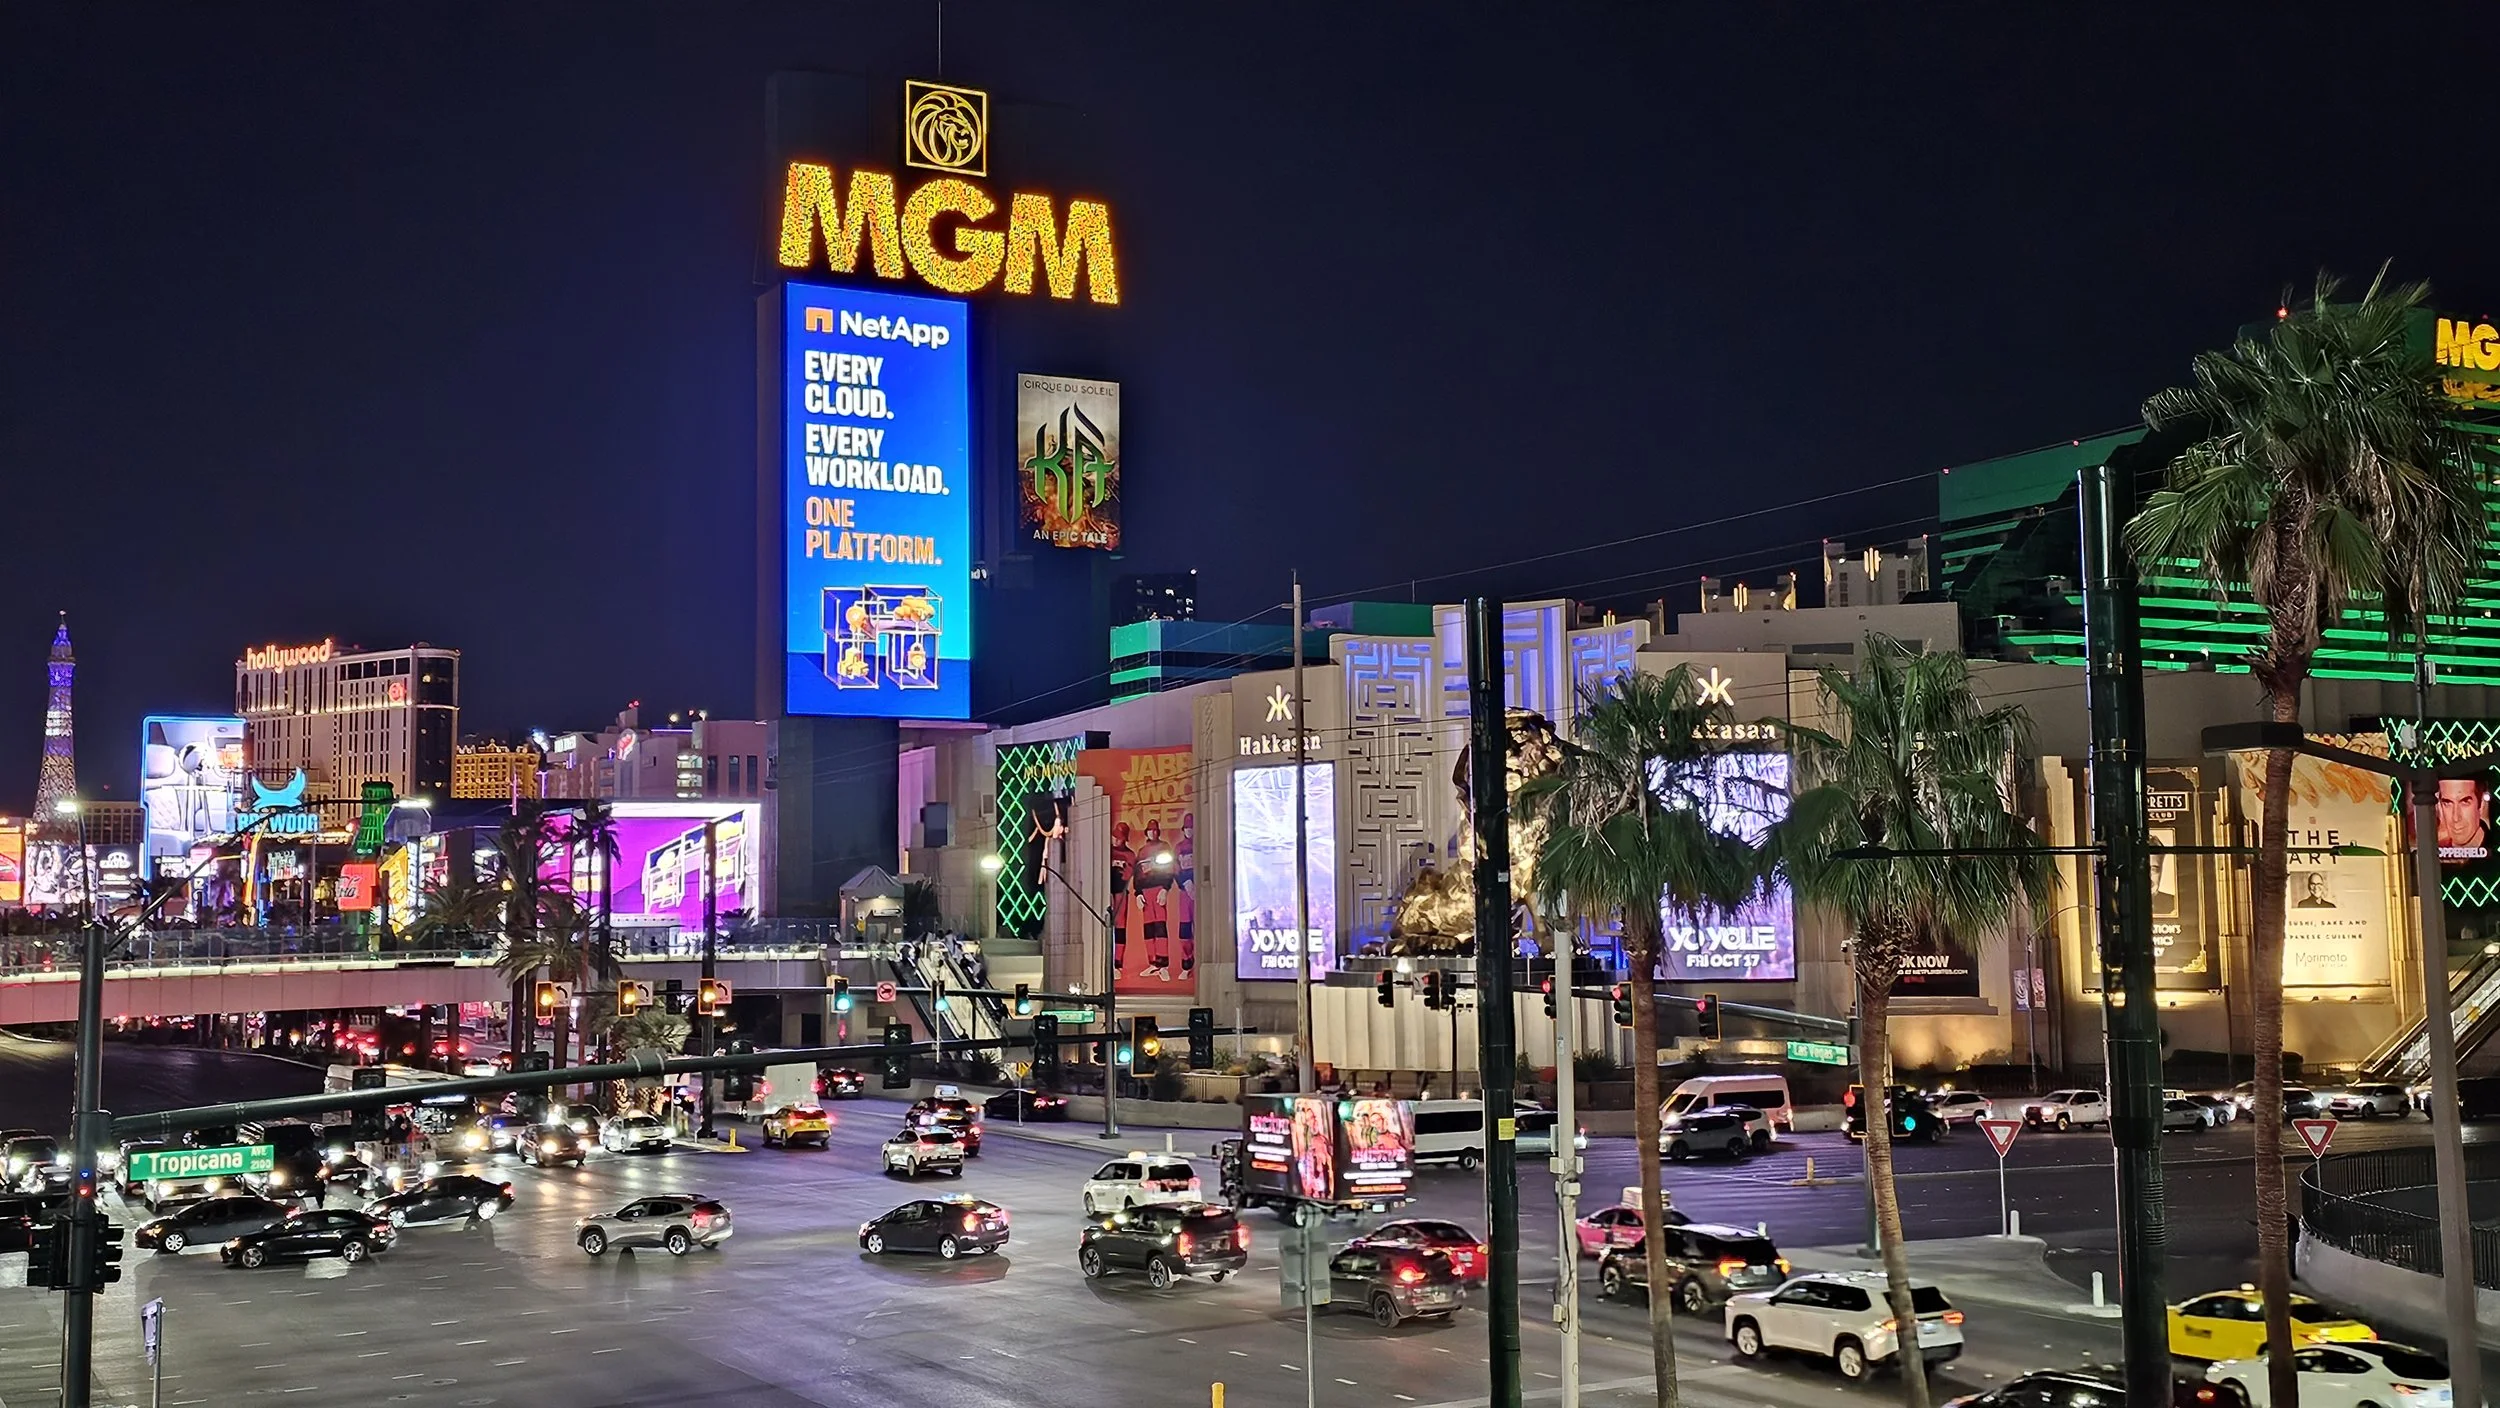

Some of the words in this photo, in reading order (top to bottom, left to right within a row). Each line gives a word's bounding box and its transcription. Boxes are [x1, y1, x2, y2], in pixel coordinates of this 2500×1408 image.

[779, 162, 1119, 305] MGM
[840, 310, 950, 350] NetApp
[2436, 318, 2500, 371] MG
[805, 350, 884, 387] EVERY
[804, 383, 895, 420] CLOUD.
[1024, 380, 1062, 394] CIRQUE
[1064, 384, 1079, 393] DU
[805, 423, 885, 458] EVERY
[805, 456, 950, 496] WORKLOAD.
[805, 496, 855, 528] ONE
[805, 529, 943, 565] PLATFORM.
[1033, 530, 1049, 540] AN
[1053, 532, 1078, 542] EPIC
[1082, 533, 1108, 544] TALE
[246, 638, 332, 674] hollywood
[2287, 830, 2340, 846] THE
[1668, 926, 1705, 952] YO
[1686, 953, 1710, 968] FRI
[1710, 954, 1742, 968] OCT
[1743, 954, 1760, 967] 17
[1917, 955, 1950, 968] NOW
[2295, 952, 2348, 967] Morimoto
[148, 1151, 243, 1177] Tropicana
[251, 1146, 267, 1156] AVE
